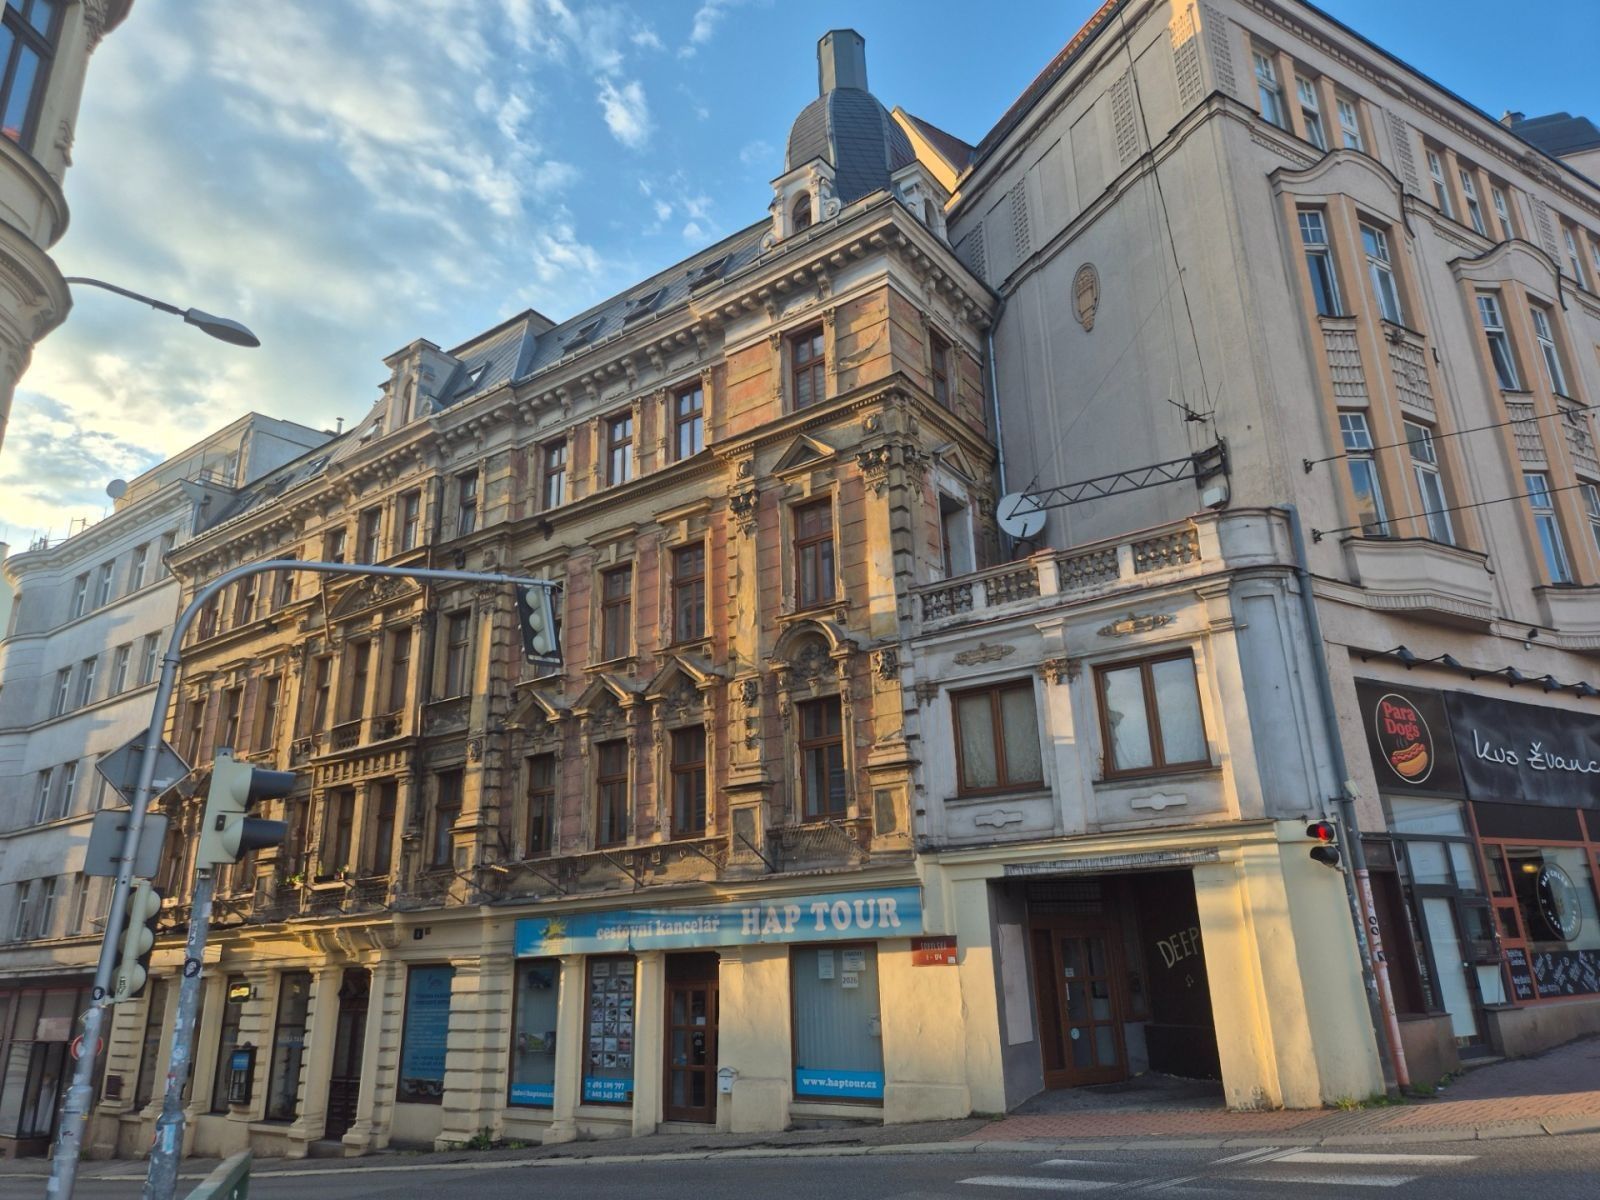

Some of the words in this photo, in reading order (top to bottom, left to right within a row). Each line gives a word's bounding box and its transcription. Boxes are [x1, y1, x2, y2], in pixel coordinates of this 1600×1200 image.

[1381, 701, 1417, 721] Para
[596, 920, 653, 940] cestovní
[655, 913, 720, 936] kancelář
[740, 904, 801, 935] HAP
[810, 897, 902, 931] TOUR
[1156, 927, 1200, 969] DEEP
[802, 1077, 877, 1089] www.haptour.cz
